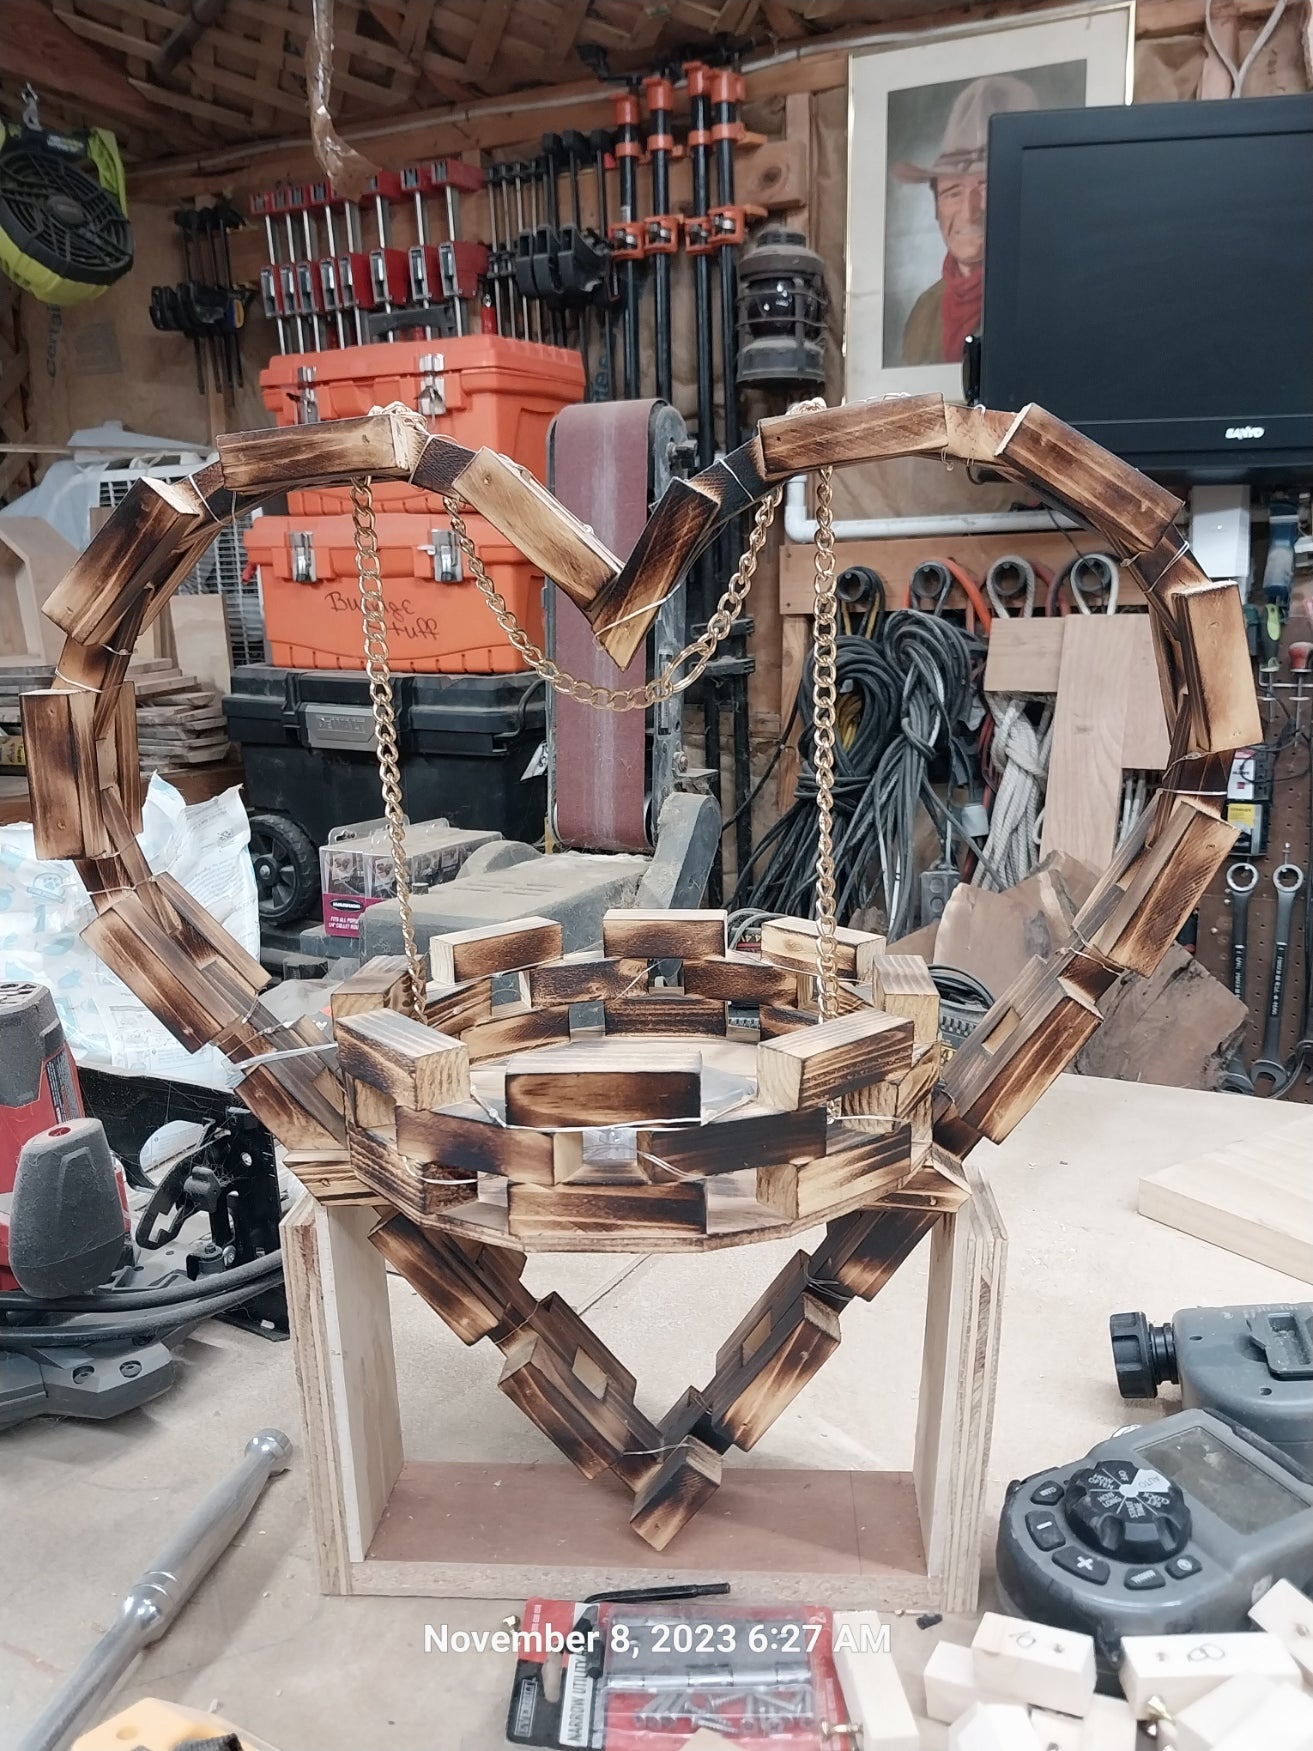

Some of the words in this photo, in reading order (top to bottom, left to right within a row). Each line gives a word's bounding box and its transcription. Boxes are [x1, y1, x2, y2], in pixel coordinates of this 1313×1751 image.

[1118, 1470, 1129, 1482] OFF
[1138, 1476, 1160, 1488] AUTO
[567, 1700, 585, 1742] NARROW
